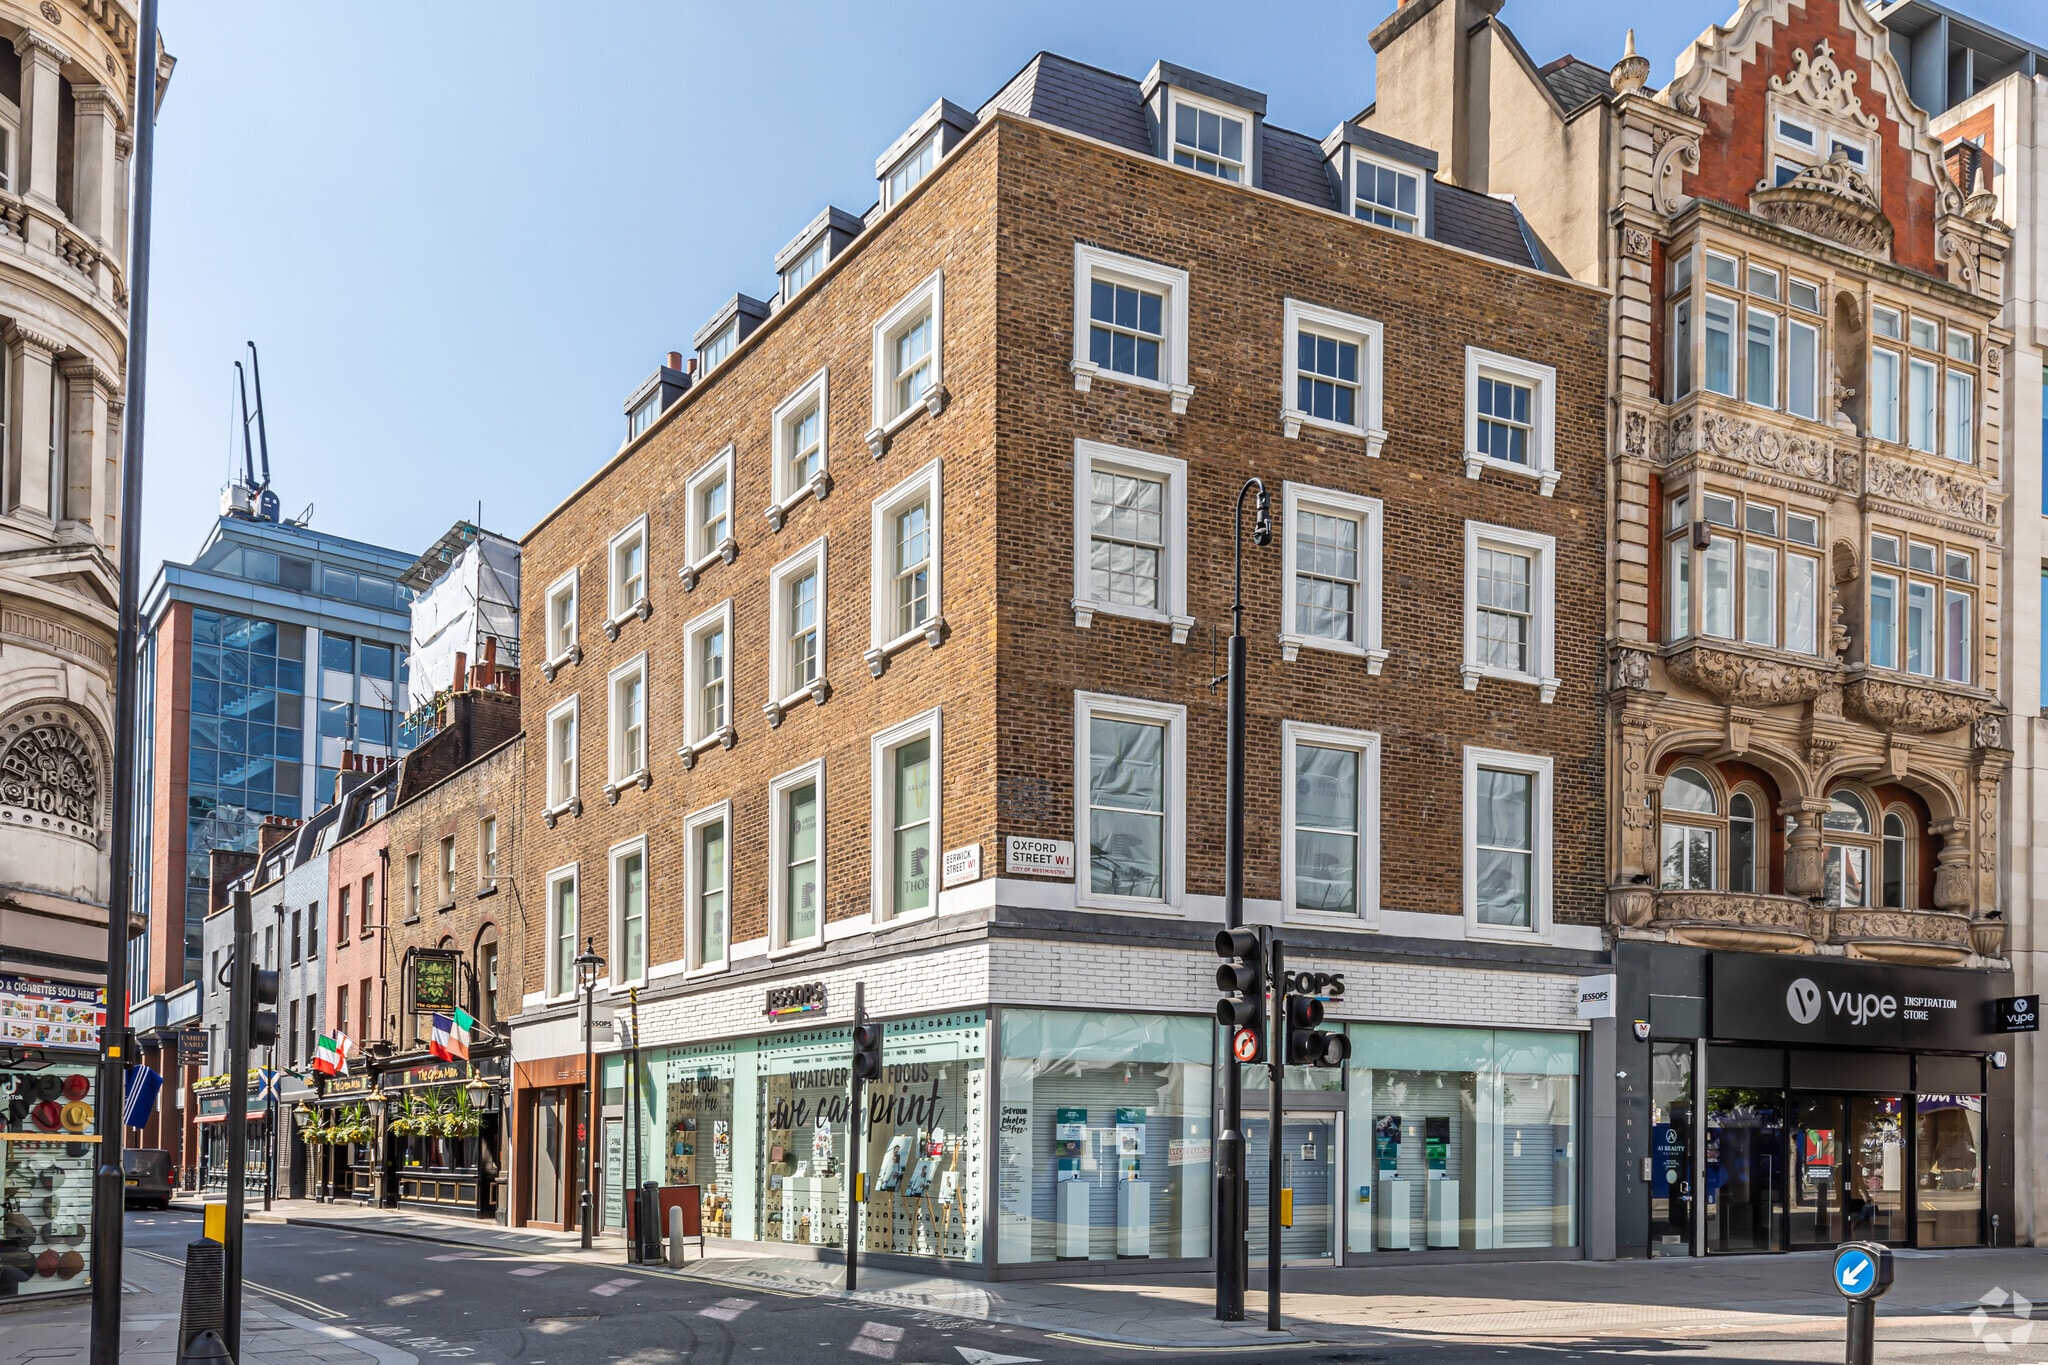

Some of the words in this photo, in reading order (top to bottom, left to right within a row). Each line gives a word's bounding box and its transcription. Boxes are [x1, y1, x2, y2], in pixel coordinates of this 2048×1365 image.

[2, 728, 96, 795] BERWICK
[22, 786, 93, 823] HOUSE
[1012, 840, 1057, 853] OXFORD
[946, 850, 971, 864] BERWICK
[1012, 851, 1052, 864] STREET
[946, 861, 966, 875] STREET
[967, 859, 976, 869] W1
[6, 982, 12, 991] &
[14, 982, 57, 996] CIGARETTES
[58, 987, 77, 998] SOLD
[78, 989, 95, 1000] HERE
[1284, 970, 1345, 996] SOPS
[762, 981, 823, 1016] JESSOPS
[1580, 992, 1608, 1003] JESSOPS
[1827, 990, 1897, 1026] vype
[1904, 996, 1957, 1009] INSPIRATION
[1904, 1010, 1929, 1020] STORE
[583, 1020, 612, 1028] JSSOPS
[2006, 1013, 2035, 1025] vype
[417, 1069, 428, 1081] The
[428, 1069, 443, 1083] Green
[443, 1067, 458, 1079] Man
[789, 1066, 847, 1089] WHATEVER
[888, 1062, 929, 1083] FOCUS
[680, 1077, 695, 1093] SET
[697, 1075, 718, 1093] YOUR
[776, 1097, 810, 1130] we
[867, 1077, 945, 1143] print
[1001, 1106, 1012, 1115] Set
[1002, 1116, 1028, 1127] photos
